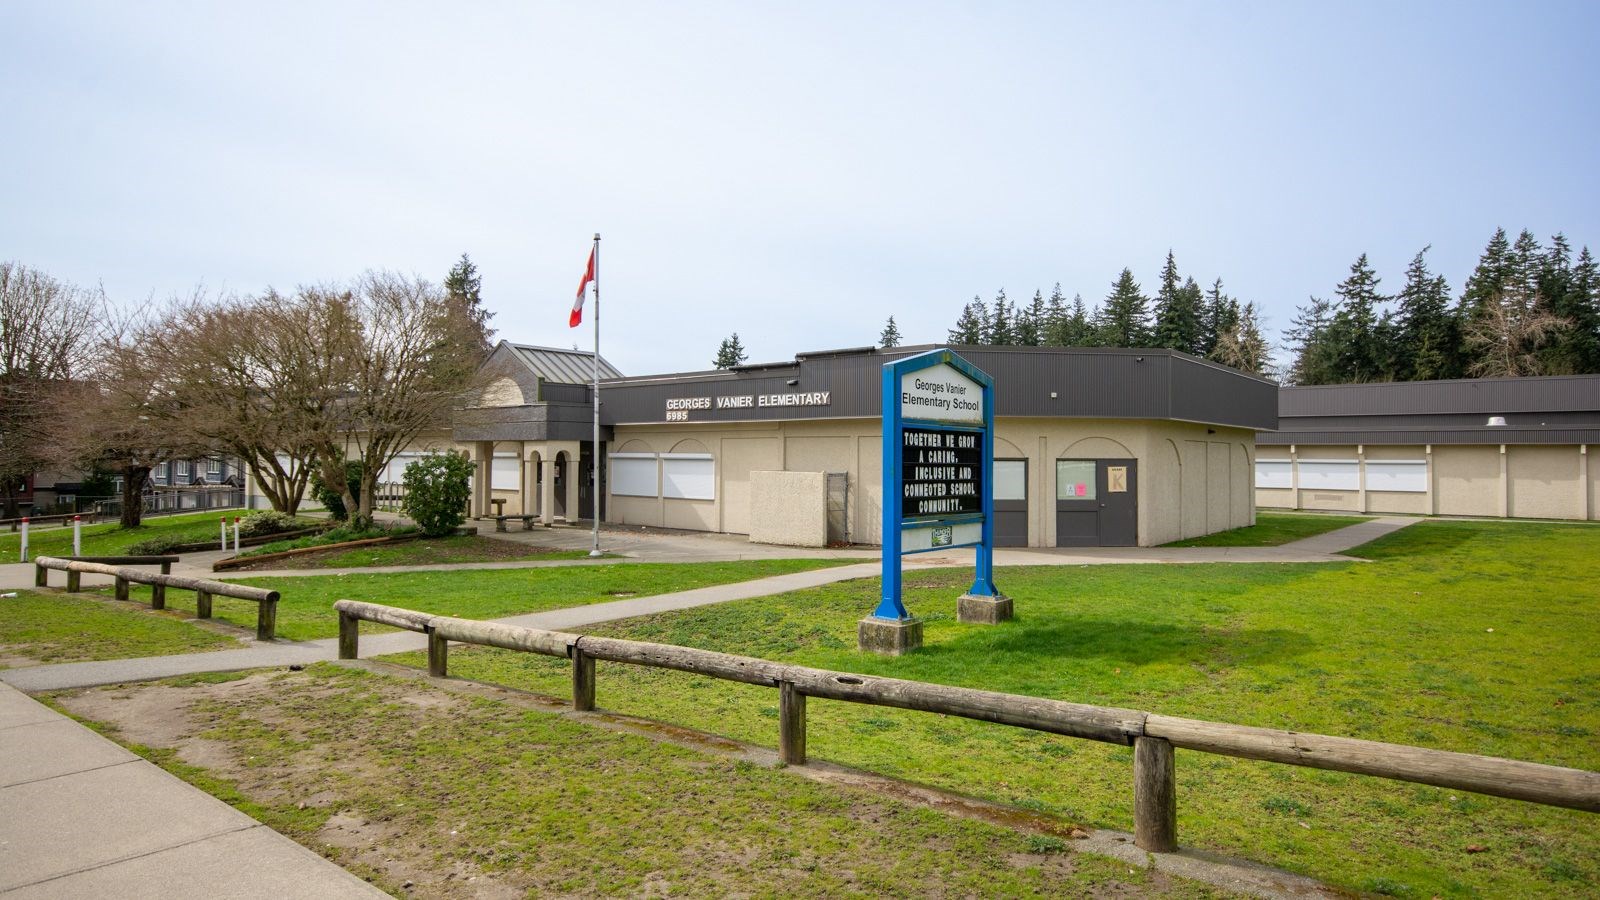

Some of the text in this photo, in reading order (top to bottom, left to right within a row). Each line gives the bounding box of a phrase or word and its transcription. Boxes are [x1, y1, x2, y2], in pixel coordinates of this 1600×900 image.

[915, 378, 966, 395] Georges Vanier
[666, 392, 830, 410] GEORGES VANIER ELEMENTARY
[902, 392, 979, 411] Elementary School
[666, 411, 688, 421] 6985
[904, 432, 975, 448] TOGETHER WE GROW
[919, 450, 924, 463] A
[915, 466, 972, 480] INCLUSIVE AND
[950, 483, 975, 495] SCHOOL
[919, 498, 963, 513] COMMUNITY.
